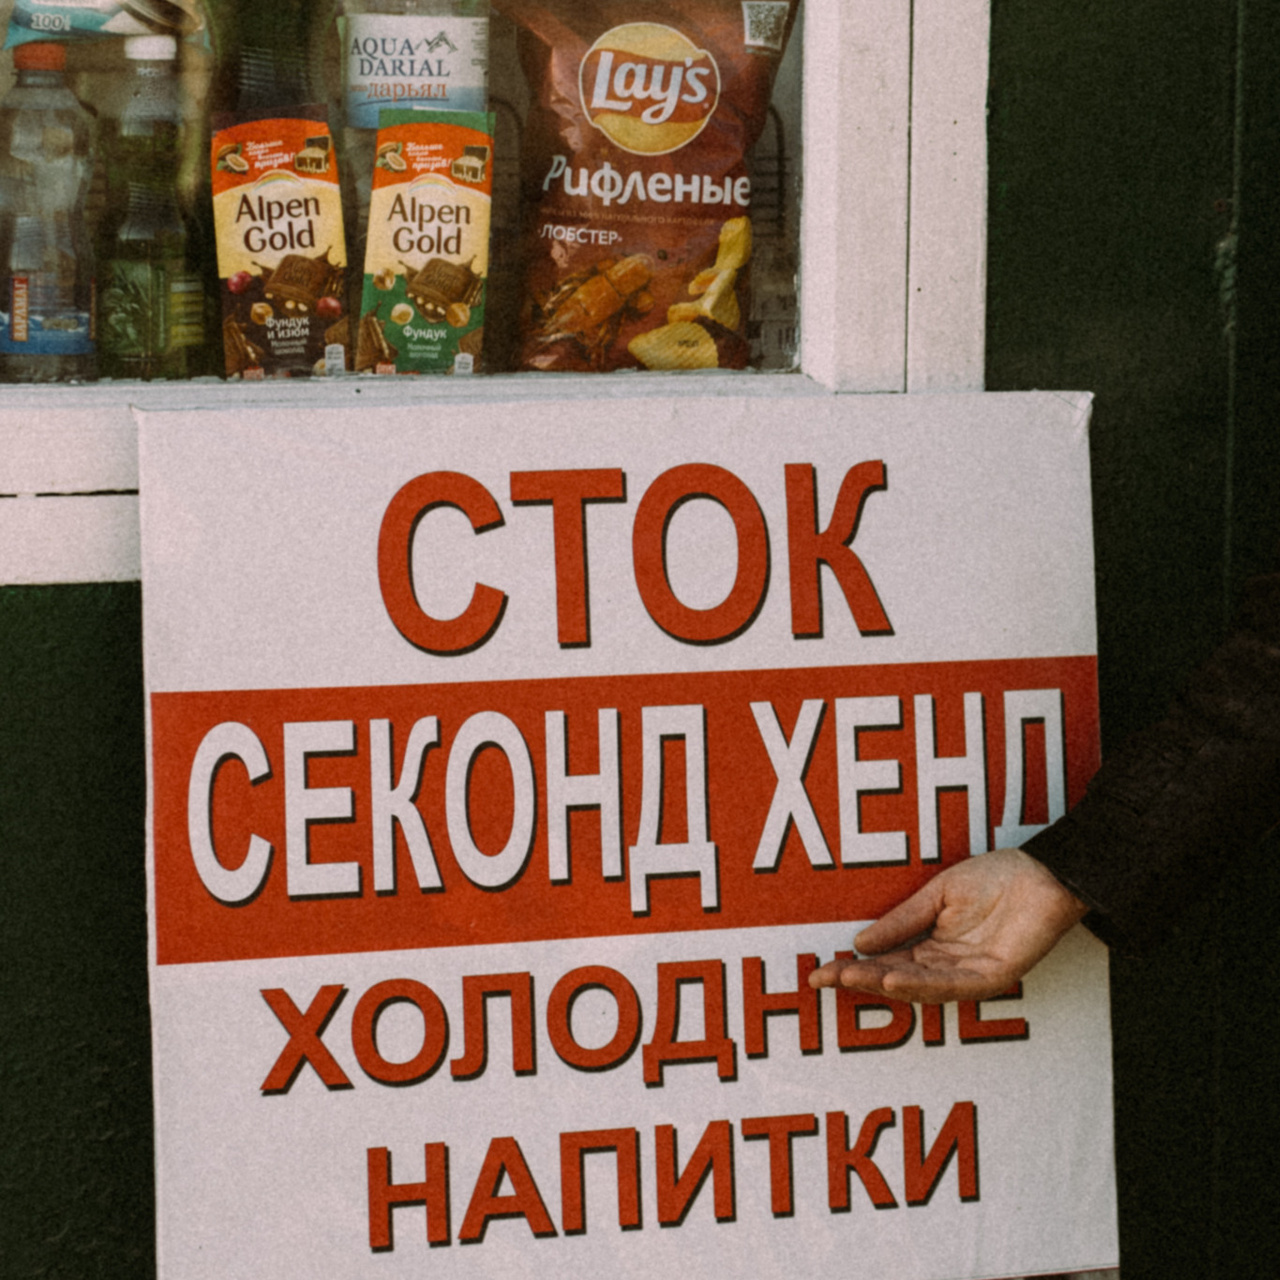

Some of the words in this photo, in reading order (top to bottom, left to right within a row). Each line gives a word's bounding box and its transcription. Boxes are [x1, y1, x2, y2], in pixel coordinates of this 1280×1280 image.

[351, 37, 415, 59] AQUA
[359, 58, 450, 77] DARIAL
[367, 82, 448, 102] дарьял
[591, 51, 710, 124] Lay's
[542, 155, 750, 207] Рифленые
[235, 193, 320, 229] Alpen
[387, 193, 471, 232] Alpen
[243, 219, 315, 253] Gold
[392, 226, 462, 255] Gold
[265, 317, 310, 331] Фундук
[402, 325, 448, 341] Фундук
[376, 459, 895, 656] СТОК
[187, 703, 721, 917] СЕКОНД
[749, 688, 1069, 874] ХЕНД
[365, 1100, 980, 1252] НАПИТКИ
